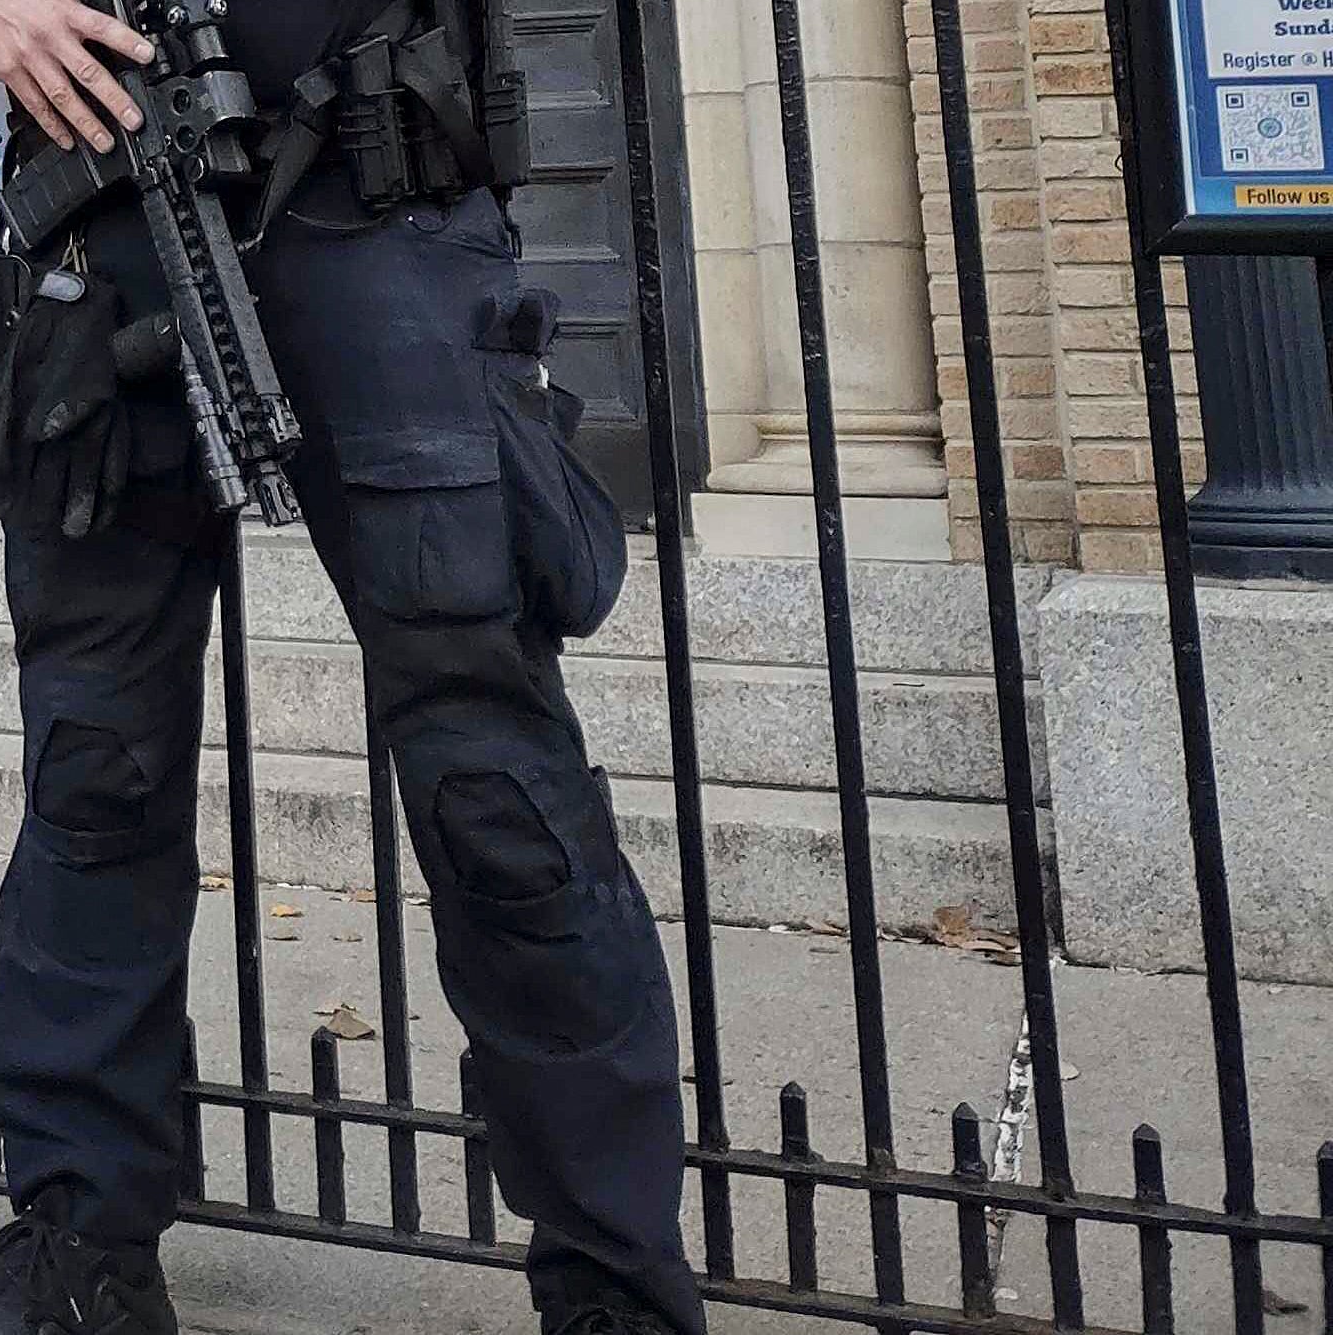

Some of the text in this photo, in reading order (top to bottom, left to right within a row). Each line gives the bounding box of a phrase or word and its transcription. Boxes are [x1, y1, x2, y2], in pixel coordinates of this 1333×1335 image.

[1274, 18, 1333, 37] Sund
[1222, 51, 1295, 72] Register
[1247, 188, 1330, 205] Follow us
